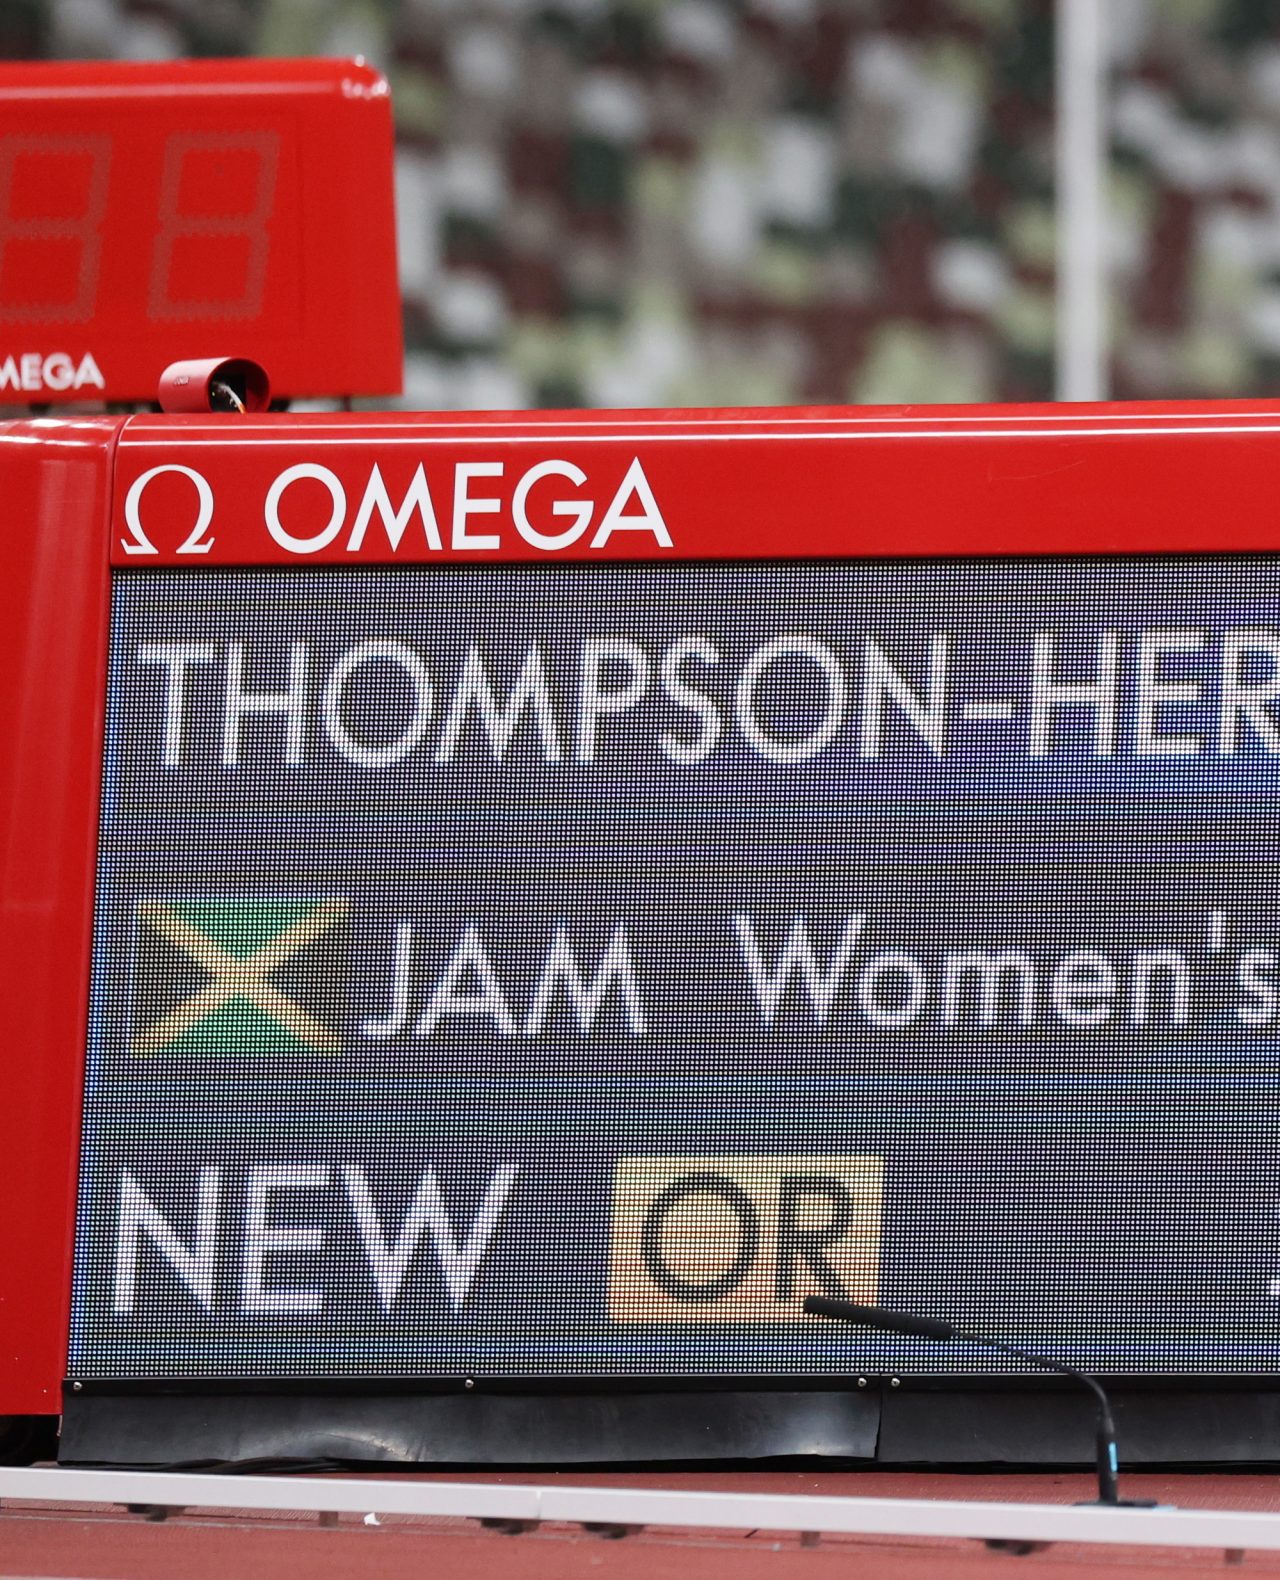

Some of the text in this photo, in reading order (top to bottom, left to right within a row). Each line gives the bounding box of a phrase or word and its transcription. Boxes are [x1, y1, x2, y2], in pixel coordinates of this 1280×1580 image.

[264, 456, 673, 553] OMEGA
[361, 921, 648, 1039] JAM
[731, 909, 1280, 1032] Women's
[112, 1162, 522, 1314] NEW
[642, 1170, 857, 1304] OR
